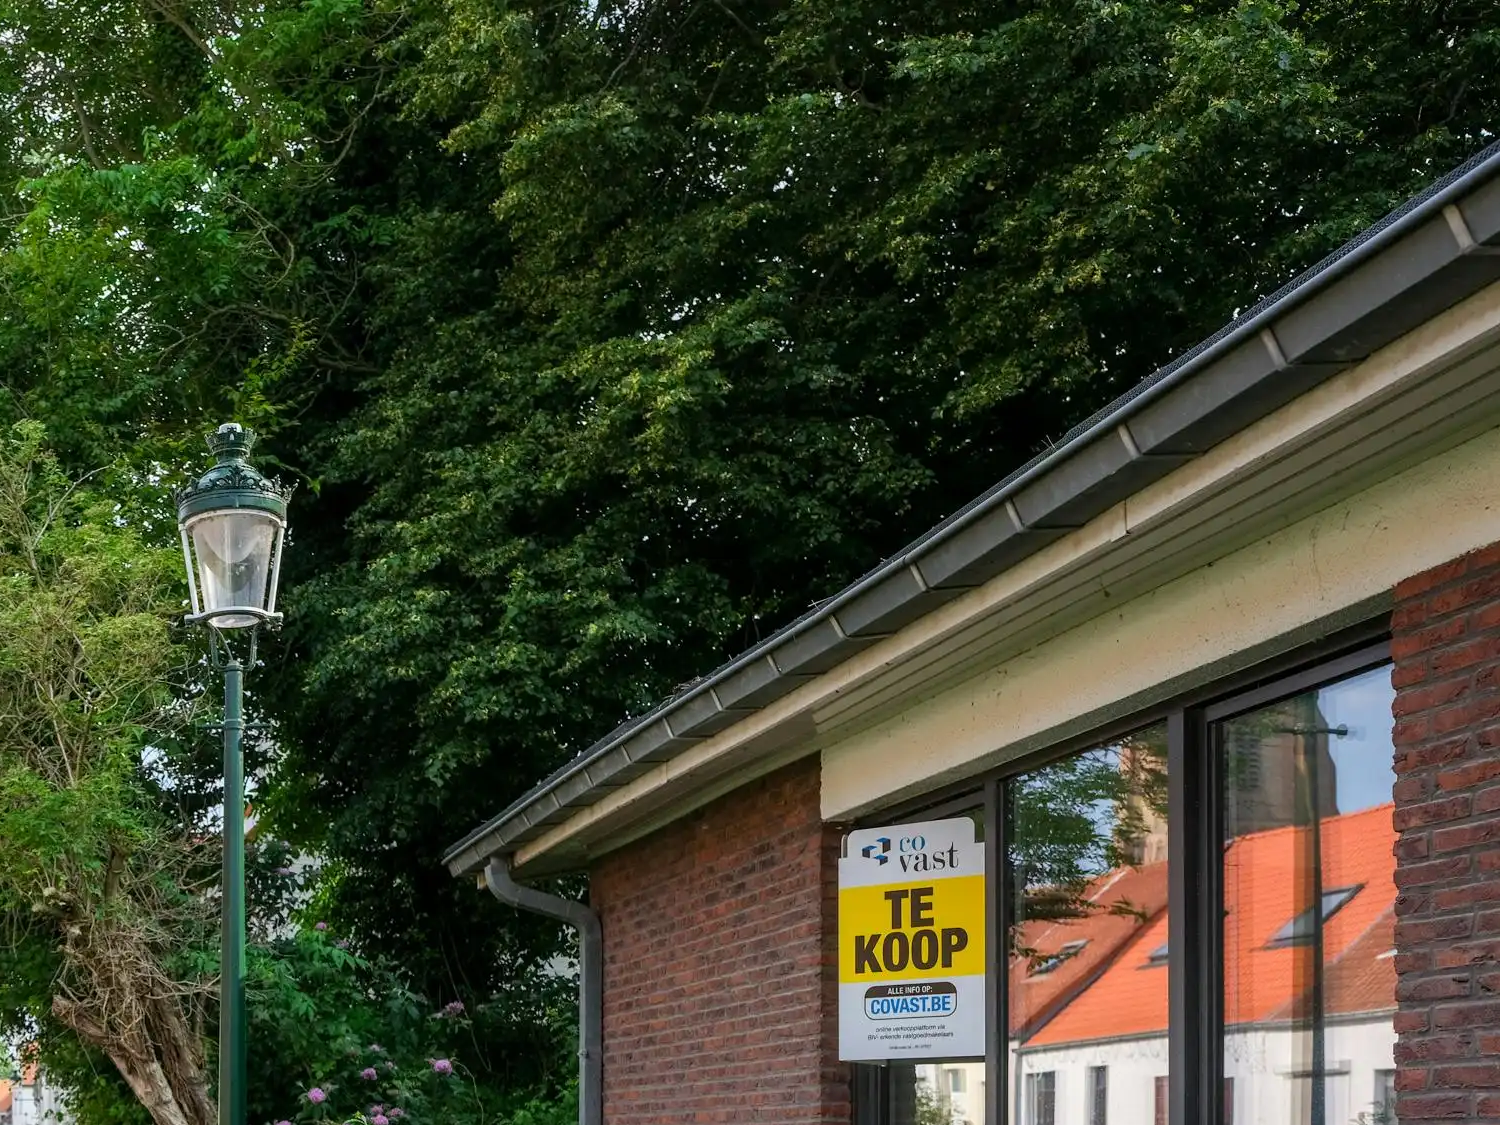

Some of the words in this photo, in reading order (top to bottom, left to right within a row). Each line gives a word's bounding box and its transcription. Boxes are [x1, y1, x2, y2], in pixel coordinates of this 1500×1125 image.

[900, 835, 925, 852] co
[900, 842, 959, 872] vast
[884, 887, 934, 929] TE
[855, 927, 968, 974] KOOP
[887, 987, 904, 995] ALLE
[905, 986, 921, 994] INFO
[921, 985, 933, 993] OP:
[870, 995, 951, 1014] COVAST.BE
